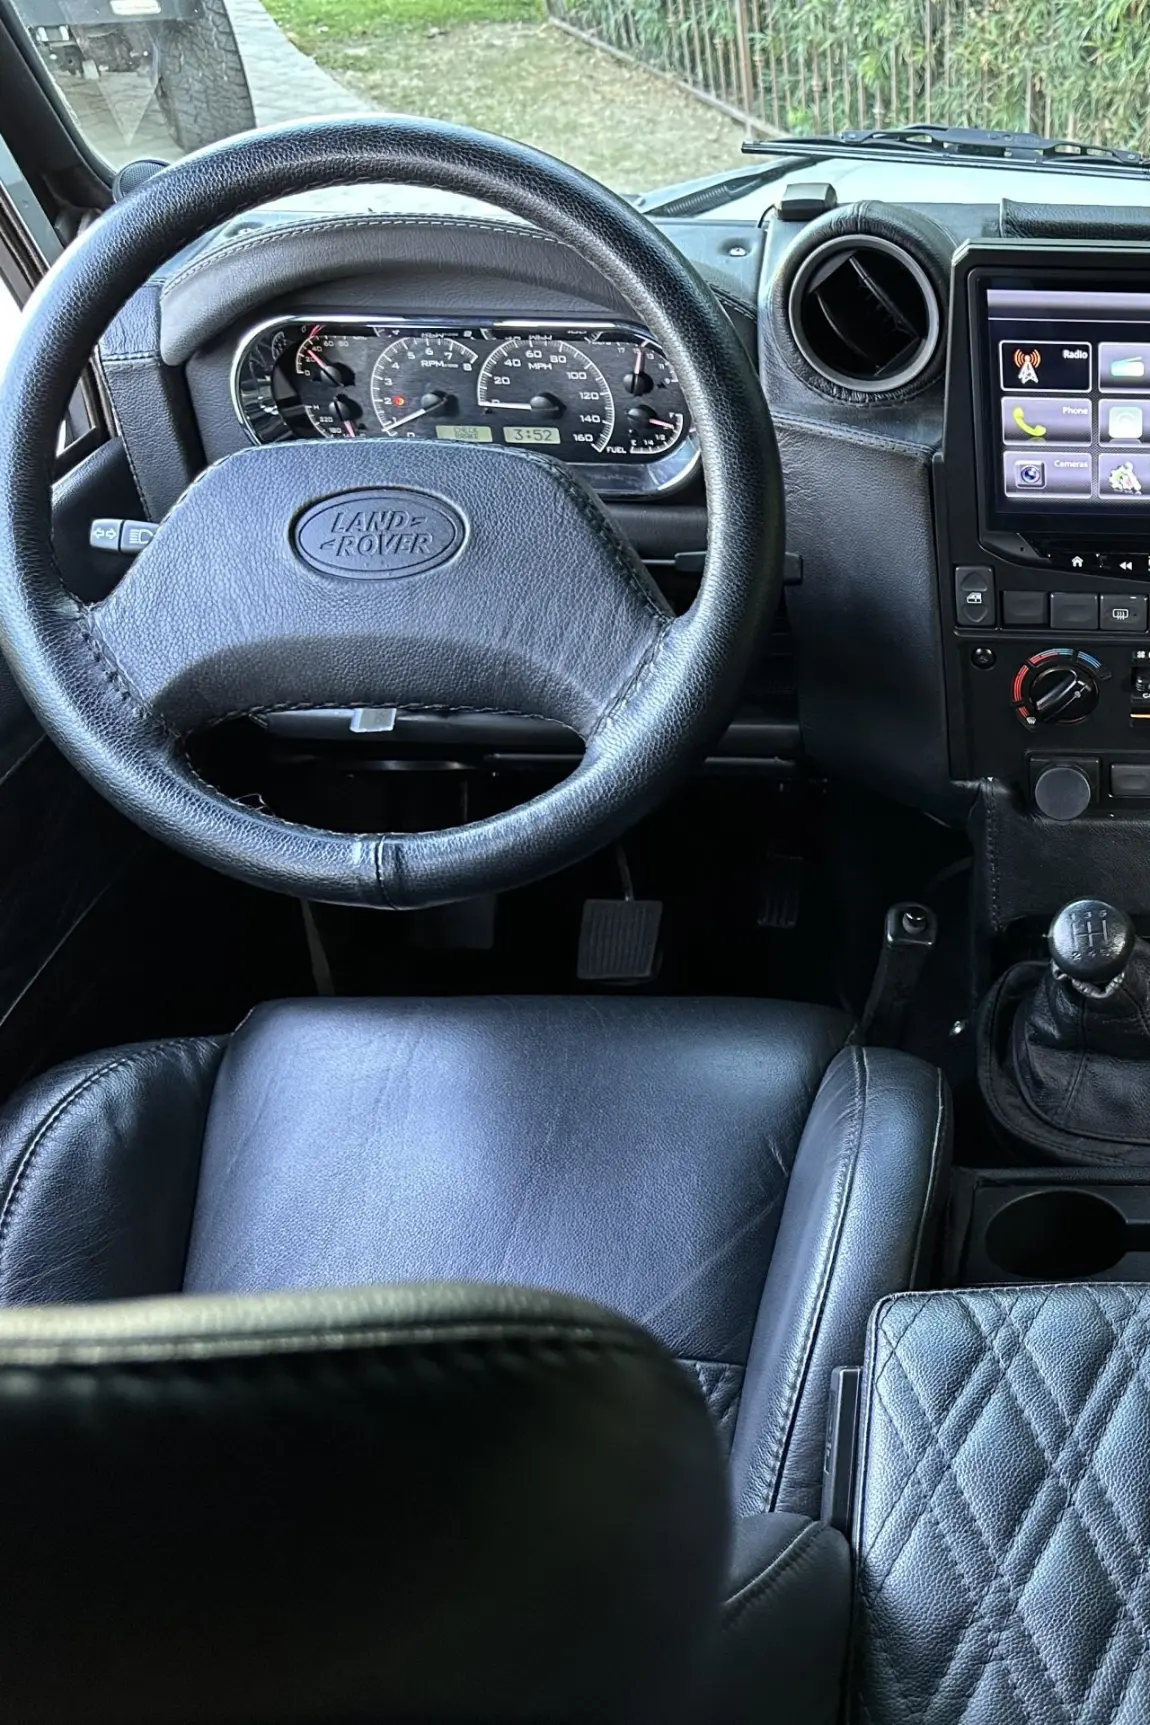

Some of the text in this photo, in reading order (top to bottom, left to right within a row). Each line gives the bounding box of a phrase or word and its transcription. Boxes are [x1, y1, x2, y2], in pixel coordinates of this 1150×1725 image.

[407, 351, 415, 359] 5
[425, 347, 433, 355] 6
[525, 350, 542, 358] 60
[1063, 350, 1088, 359] Radio
[444, 352, 453, 360] 7
[550, 355, 567, 363] 80
[421, 360, 444, 368] RPM
[463, 363, 472, 371] 8
[504, 359, 521, 367] 40
[384, 378, 392, 386] 3
[493, 377, 510, 385] 20
[579, 392, 599, 400] 120
[384, 397, 392, 405] 2
[512, 428, 552, 441] 3:52
[573, 434, 593, 442] 160
[607, 446, 627, 454] FUEL
[1054, 460, 1088, 468] Cameras
[331, 510, 410, 533] LAND
[335, 533, 433, 557] ROVER
